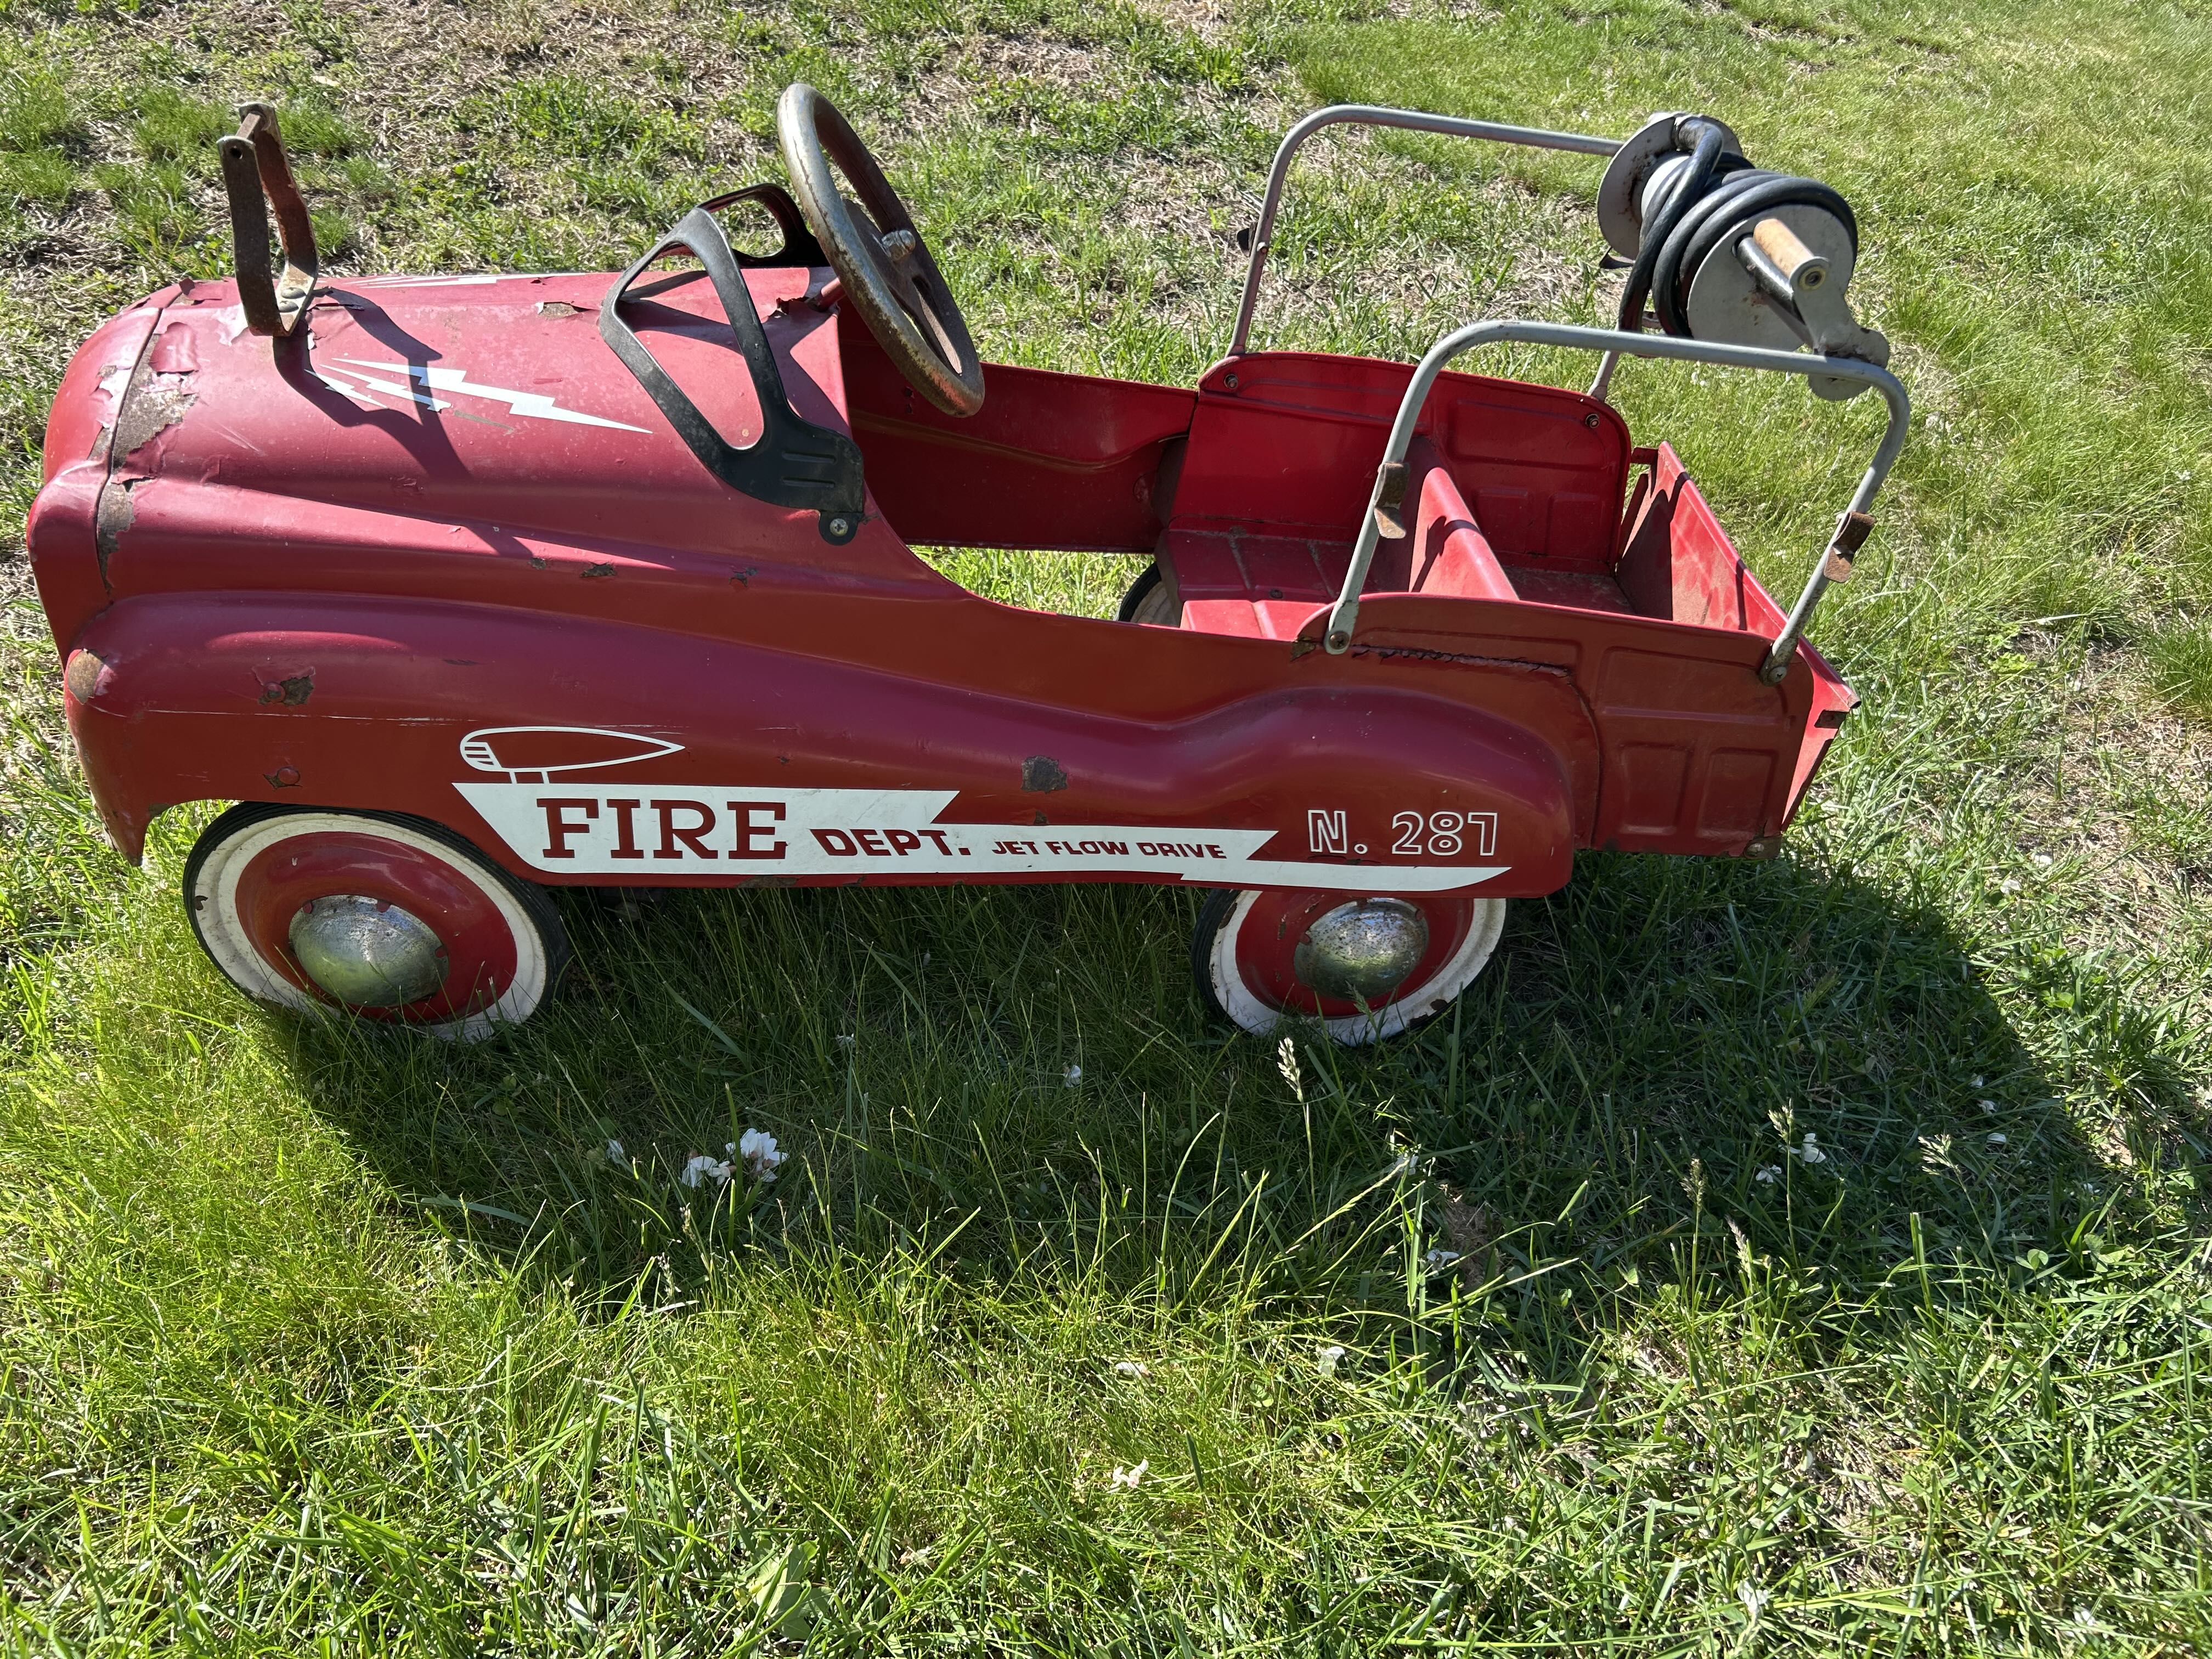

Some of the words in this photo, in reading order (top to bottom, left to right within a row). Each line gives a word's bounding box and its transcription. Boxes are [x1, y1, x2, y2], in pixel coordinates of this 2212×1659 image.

[537, 798, 787, 859] FIRE
[809, 828, 972, 856] DEPT.
[992, 842, 1041, 855] JET
[1044, 841, 1130, 855] FLOW
[1136, 842, 1227, 859] DRIVE
[1307, 809, 1368, 854] N.
